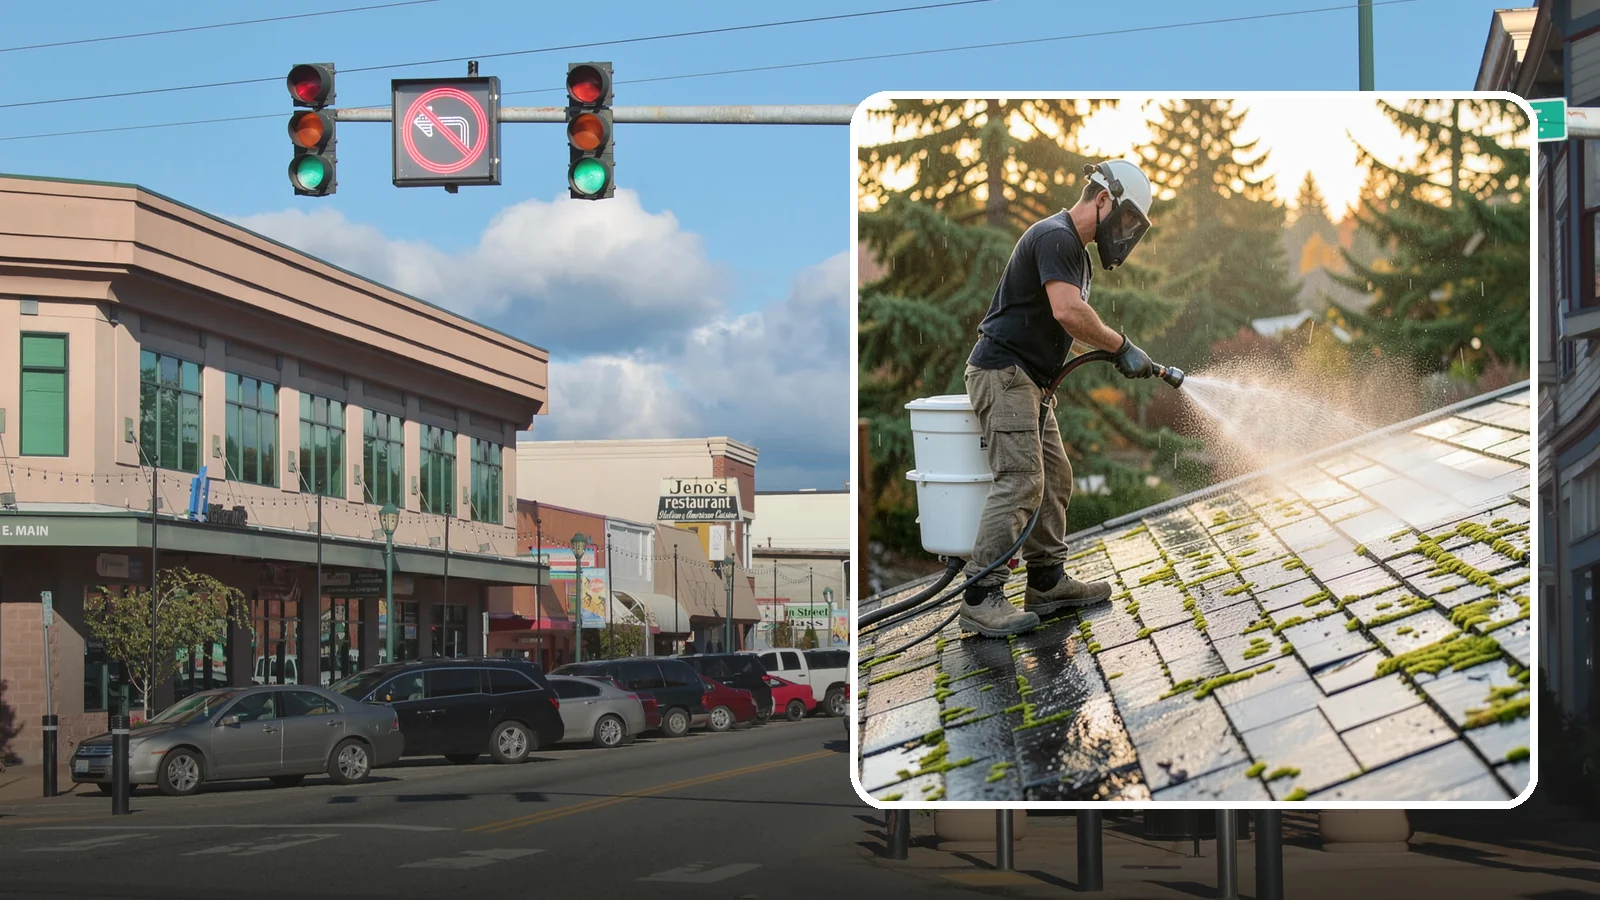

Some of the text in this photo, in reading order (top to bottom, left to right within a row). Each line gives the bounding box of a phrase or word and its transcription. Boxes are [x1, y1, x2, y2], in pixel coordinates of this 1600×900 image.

[670, 480, 727, 494] Jeno's
[665, 496, 731, 509] restaurant
[659, 510, 681, 519] Italian
[686, 509, 714, 519] American
[715, 509, 737, 519] Cuisine
[2, 525, 49, 536] E. MAIN
[797, 608, 828, 616] Street
